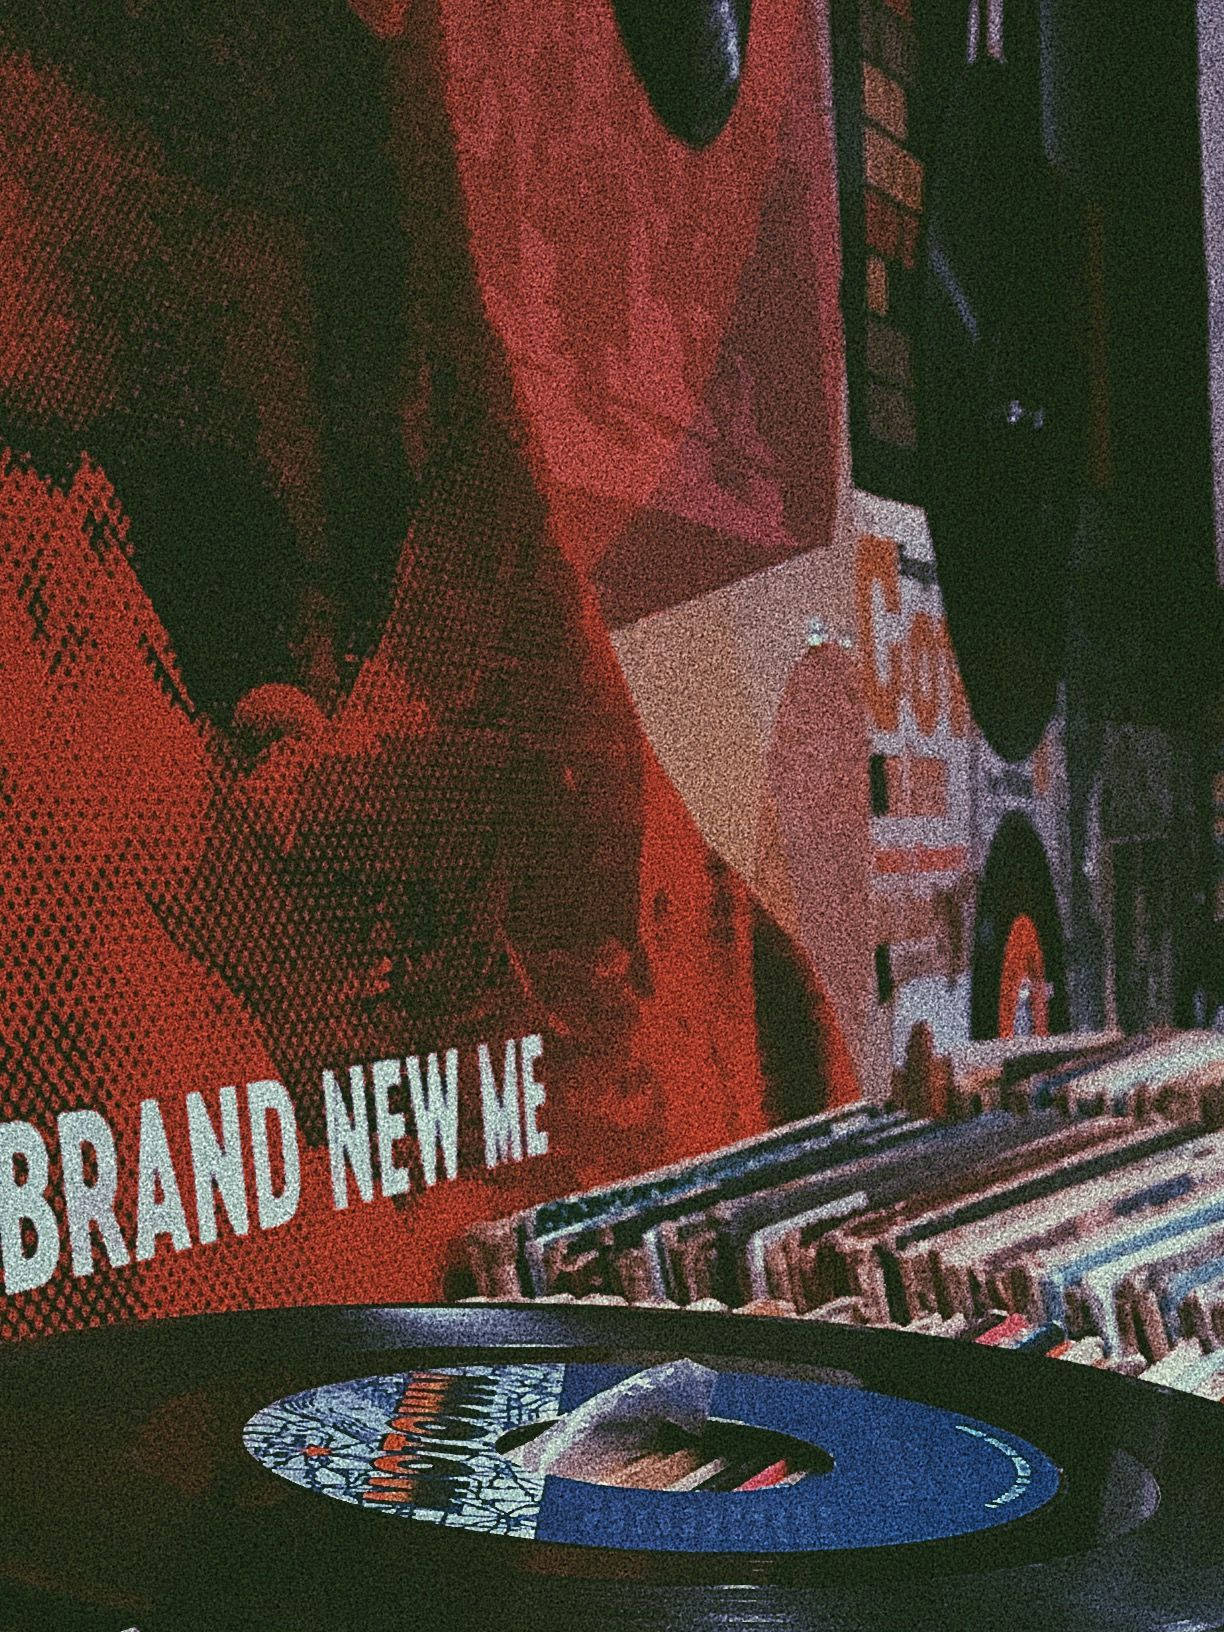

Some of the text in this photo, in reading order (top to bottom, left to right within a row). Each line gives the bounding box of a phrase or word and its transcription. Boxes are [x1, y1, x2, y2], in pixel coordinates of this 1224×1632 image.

[0, 1033, 549, 1295] BRAND NEW ME
